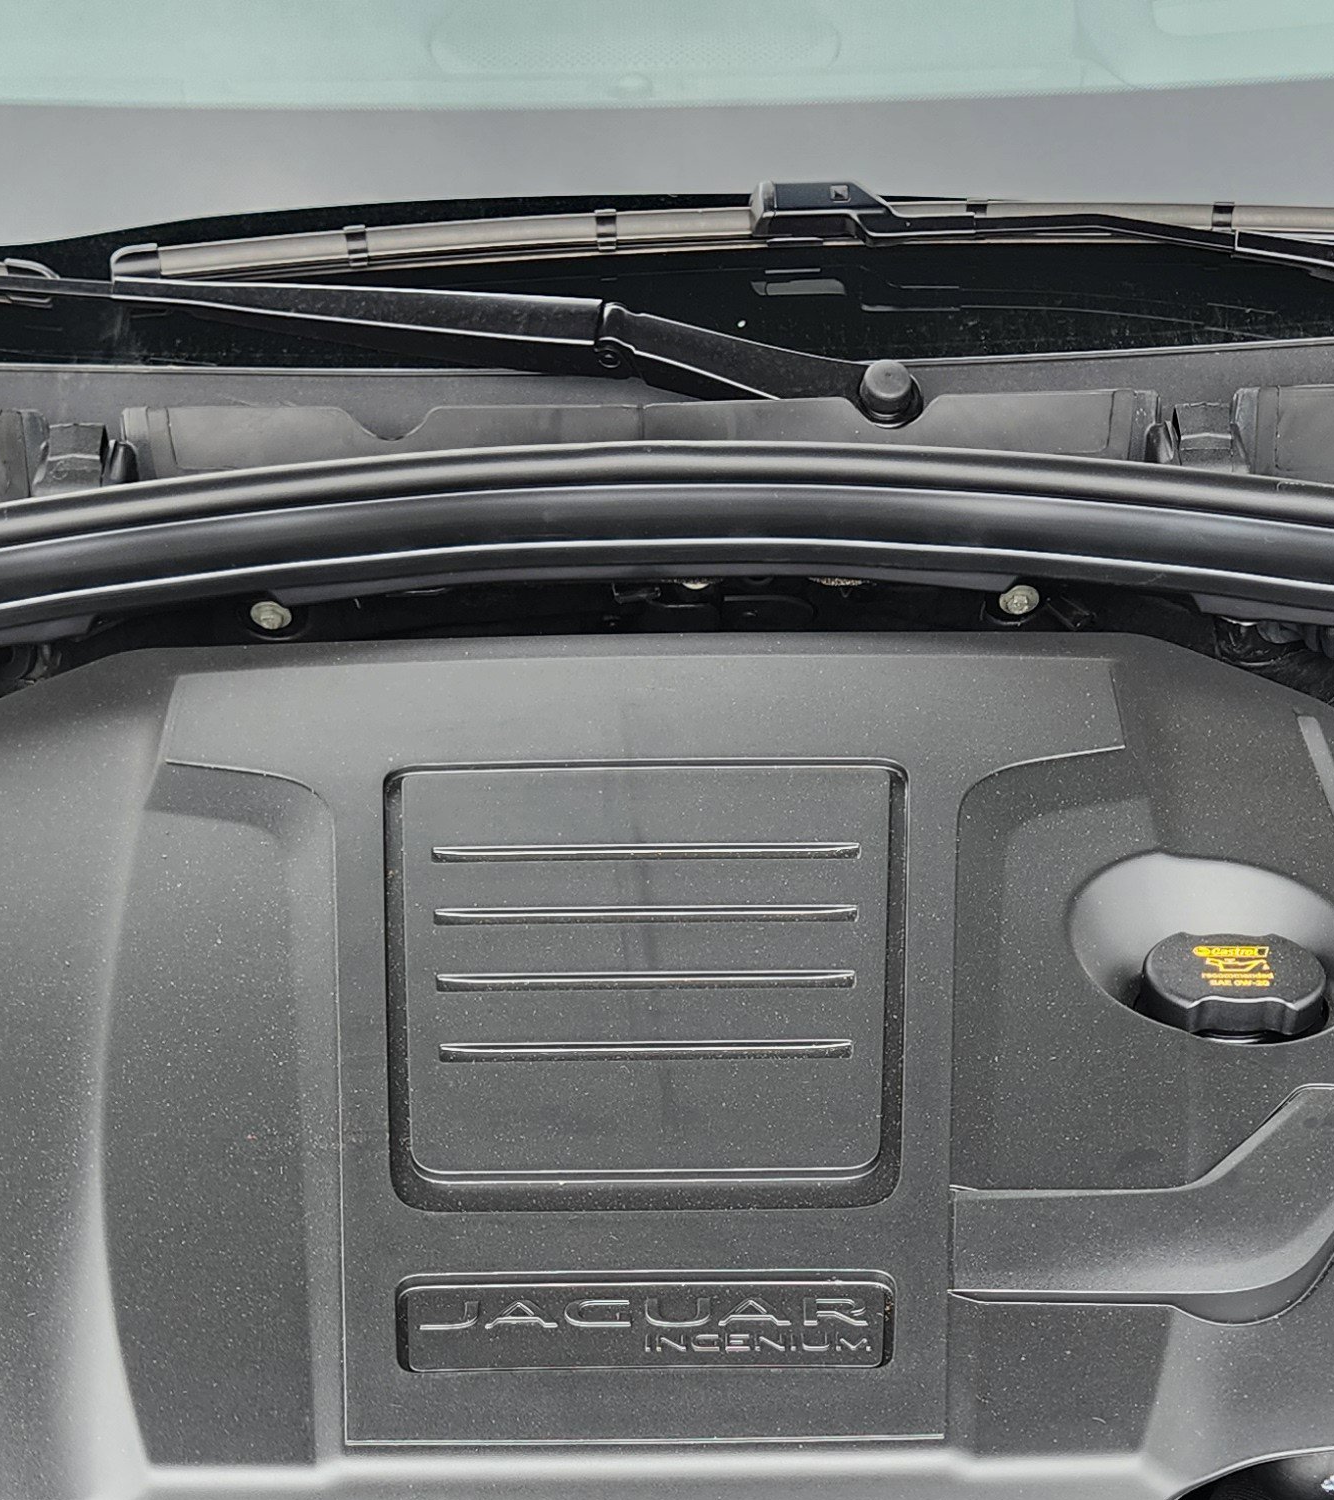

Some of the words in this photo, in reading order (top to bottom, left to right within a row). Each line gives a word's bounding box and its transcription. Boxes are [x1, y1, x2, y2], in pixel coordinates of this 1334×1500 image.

[1210, 946, 1258, 958] Castrol
[1201, 971, 1275, 980] recommended
[1209, 979, 1233, 987] SAE
[419, 1297, 869, 1331] JAGUAR
[643, 1332, 872, 1353] INGENIUM
